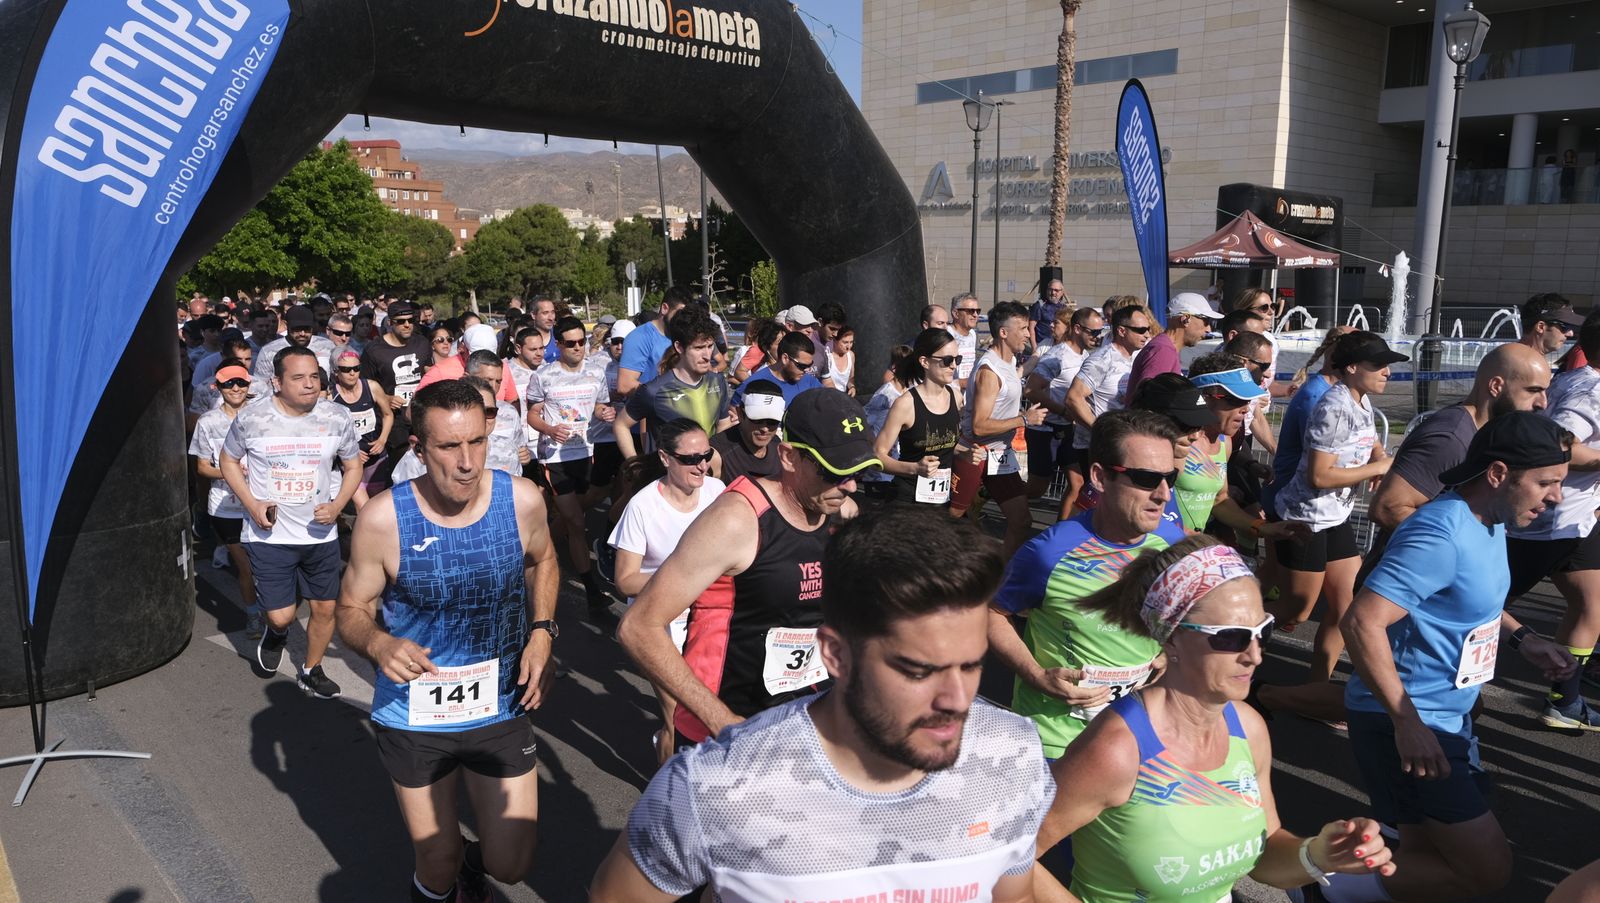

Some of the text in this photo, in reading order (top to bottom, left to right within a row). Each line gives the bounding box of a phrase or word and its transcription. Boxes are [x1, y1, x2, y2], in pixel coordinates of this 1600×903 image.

[602, 29, 760, 68] cronometraje deportivo
[155, 23, 279, 225] centrohogarsanchez.es
[274, 480, 315, 492] 1139
[798, 561, 822, 579] YES
[799, 590, 822, 601] CANCER
[800, 578, 822, 592] WITH
[785, 645, 815, 670] 39
[429, 681, 480, 705] 141
[1198, 834, 1264, 876] SAKAT
[930, 882, 980, 903] HUMO
